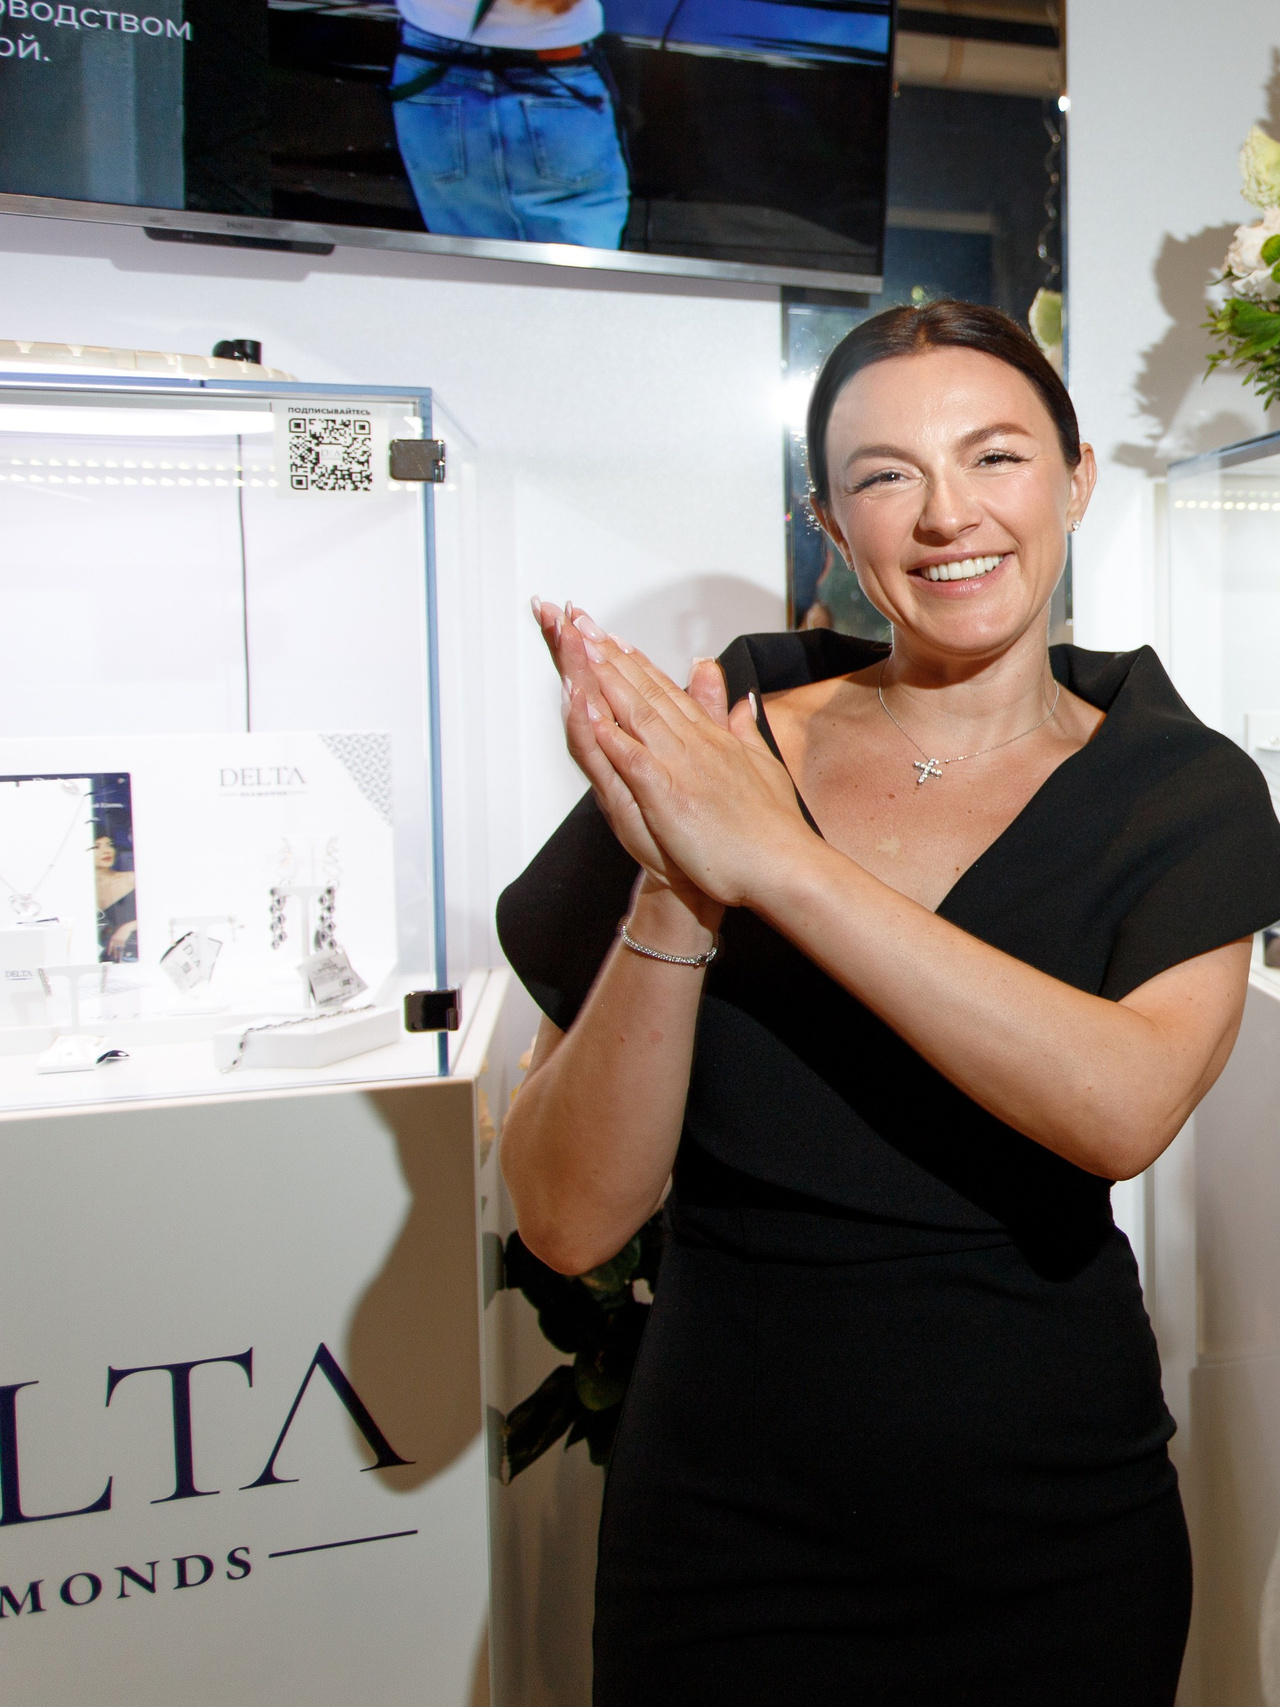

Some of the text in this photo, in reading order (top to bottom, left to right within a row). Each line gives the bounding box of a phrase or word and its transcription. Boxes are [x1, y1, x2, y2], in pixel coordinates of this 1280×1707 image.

[0, 0, 193, 41] ВОДСТВОМ
[288, 407, 371, 415] ПОДПИСЫВАЙТЕСЬ
[220, 766, 306, 786] DELTA
[5, 970, 33, 978] DELTA
